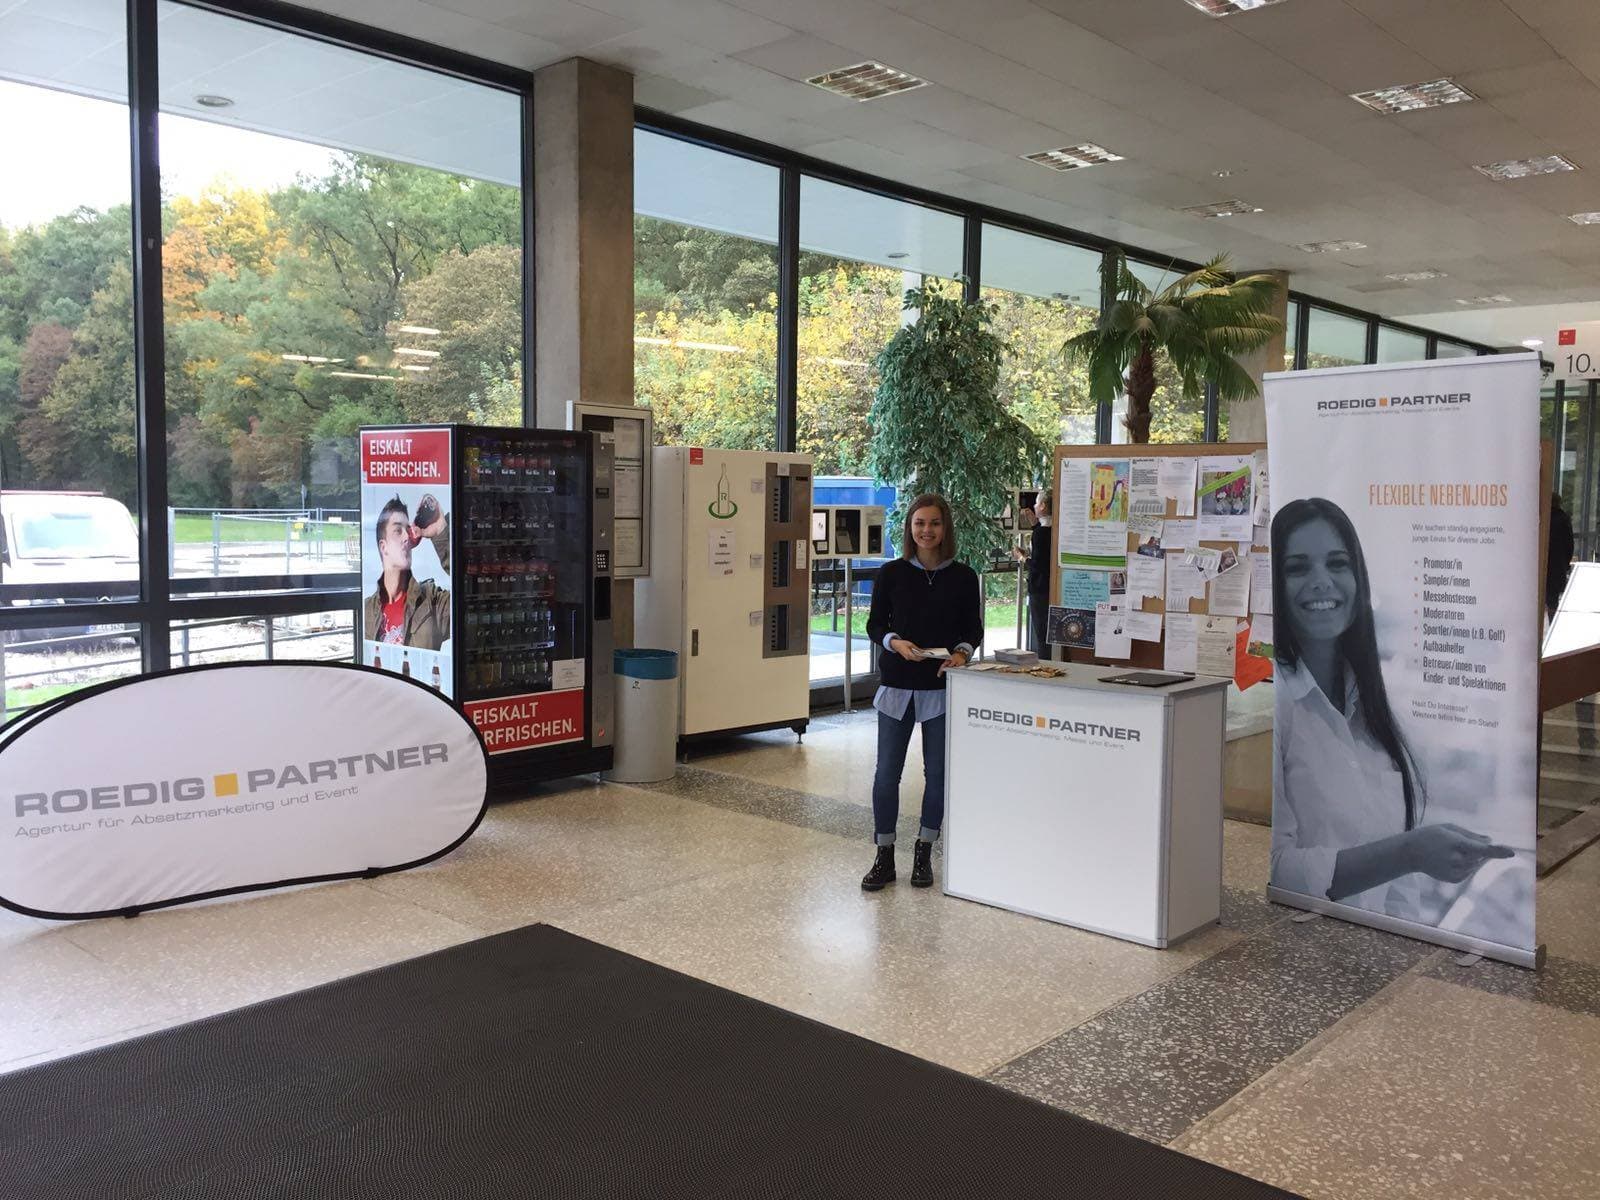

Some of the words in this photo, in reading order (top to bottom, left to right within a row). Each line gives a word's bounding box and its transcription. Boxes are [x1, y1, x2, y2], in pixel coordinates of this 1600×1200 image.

[1317, 398, 1377, 411] ROEDIG
[1390, 393, 1471, 407] PARTNER
[369, 439, 413, 456] EISKALT
[369, 461, 441, 478] ERFRISCHEN.
[1369, 484, 1425, 506] FLEXIBLE
[1430, 484, 1508, 507] NEBENJOBS
[1423, 573, 1471, 588] Sampler/innen
[1423, 590, 1477, 605] Messehostessen
[1423, 607, 1465, 621] Moderatoren
[1423, 623, 1470, 639] Sportler/innen
[1423, 640, 1465, 655] Aufbauhelfer
[1423, 656, 1473, 673] Betreuer/innen
[1474, 663, 1487, 674] von
[1423, 672, 1446, 685] Kinder-
[1447, 675, 1460, 686] und
[1461, 675, 1506, 692] Spielaktionen
[473, 702, 539, 725] EISKALT
[480, 718, 577, 746] RFRISCHEN.
[967, 707, 1033, 727] ROEDIG
[1049, 719, 1141, 742] PARTNER
[15, 777, 206, 818] ROEDIG
[247, 742, 449, 793] PARTNER
[15, 821, 92, 838] Agentur
[98, 817, 125, 829] für
[130, 799, 275, 826] Absatzmarketing
[280, 793, 310, 807] und
[314, 785, 359, 801] Event
